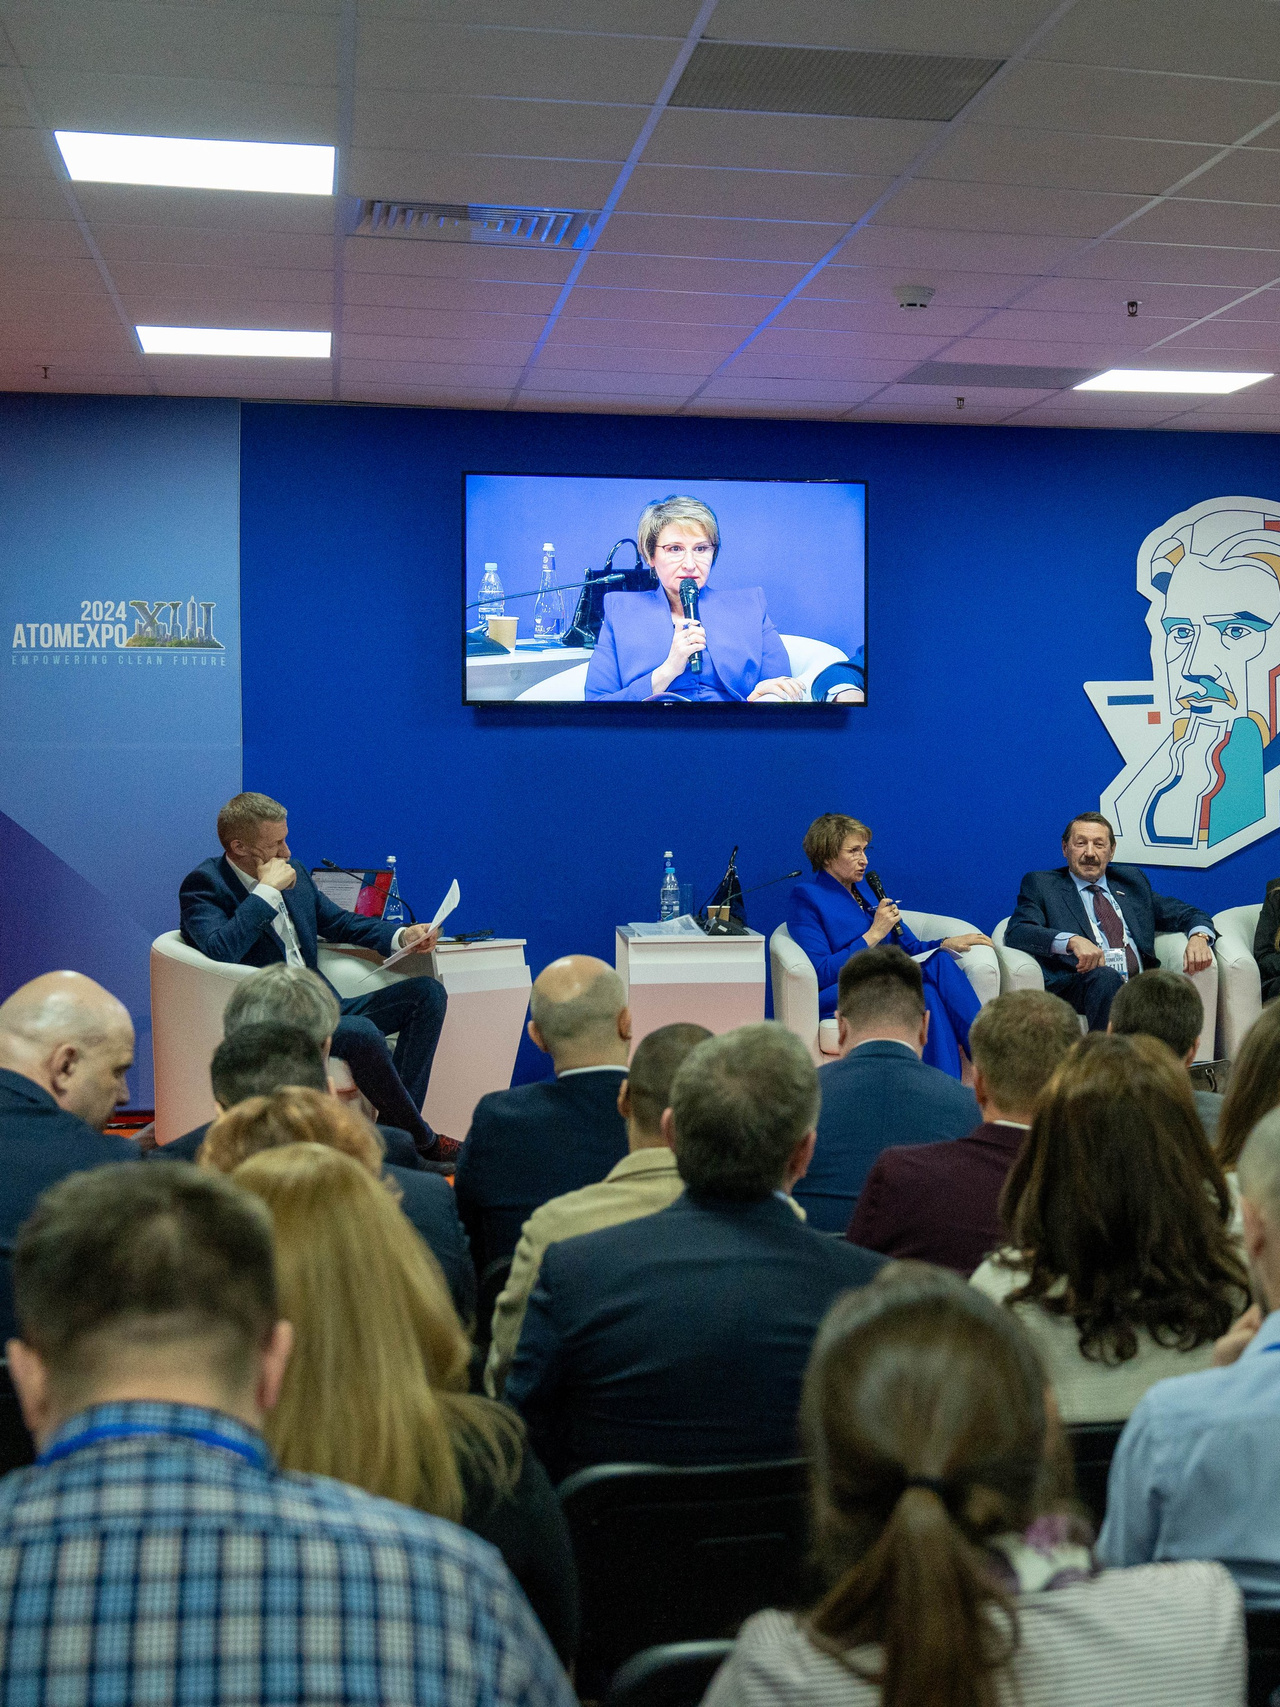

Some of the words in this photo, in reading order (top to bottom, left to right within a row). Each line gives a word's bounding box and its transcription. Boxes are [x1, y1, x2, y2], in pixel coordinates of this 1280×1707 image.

[80, 600, 127, 622] 2024
[12, 623, 127, 649] ATOMEXPO
[11, 655, 107, 666] EMPOWERING
[118, 655, 163, 666] CLEAN
[173, 655, 227, 667] FUTURE
